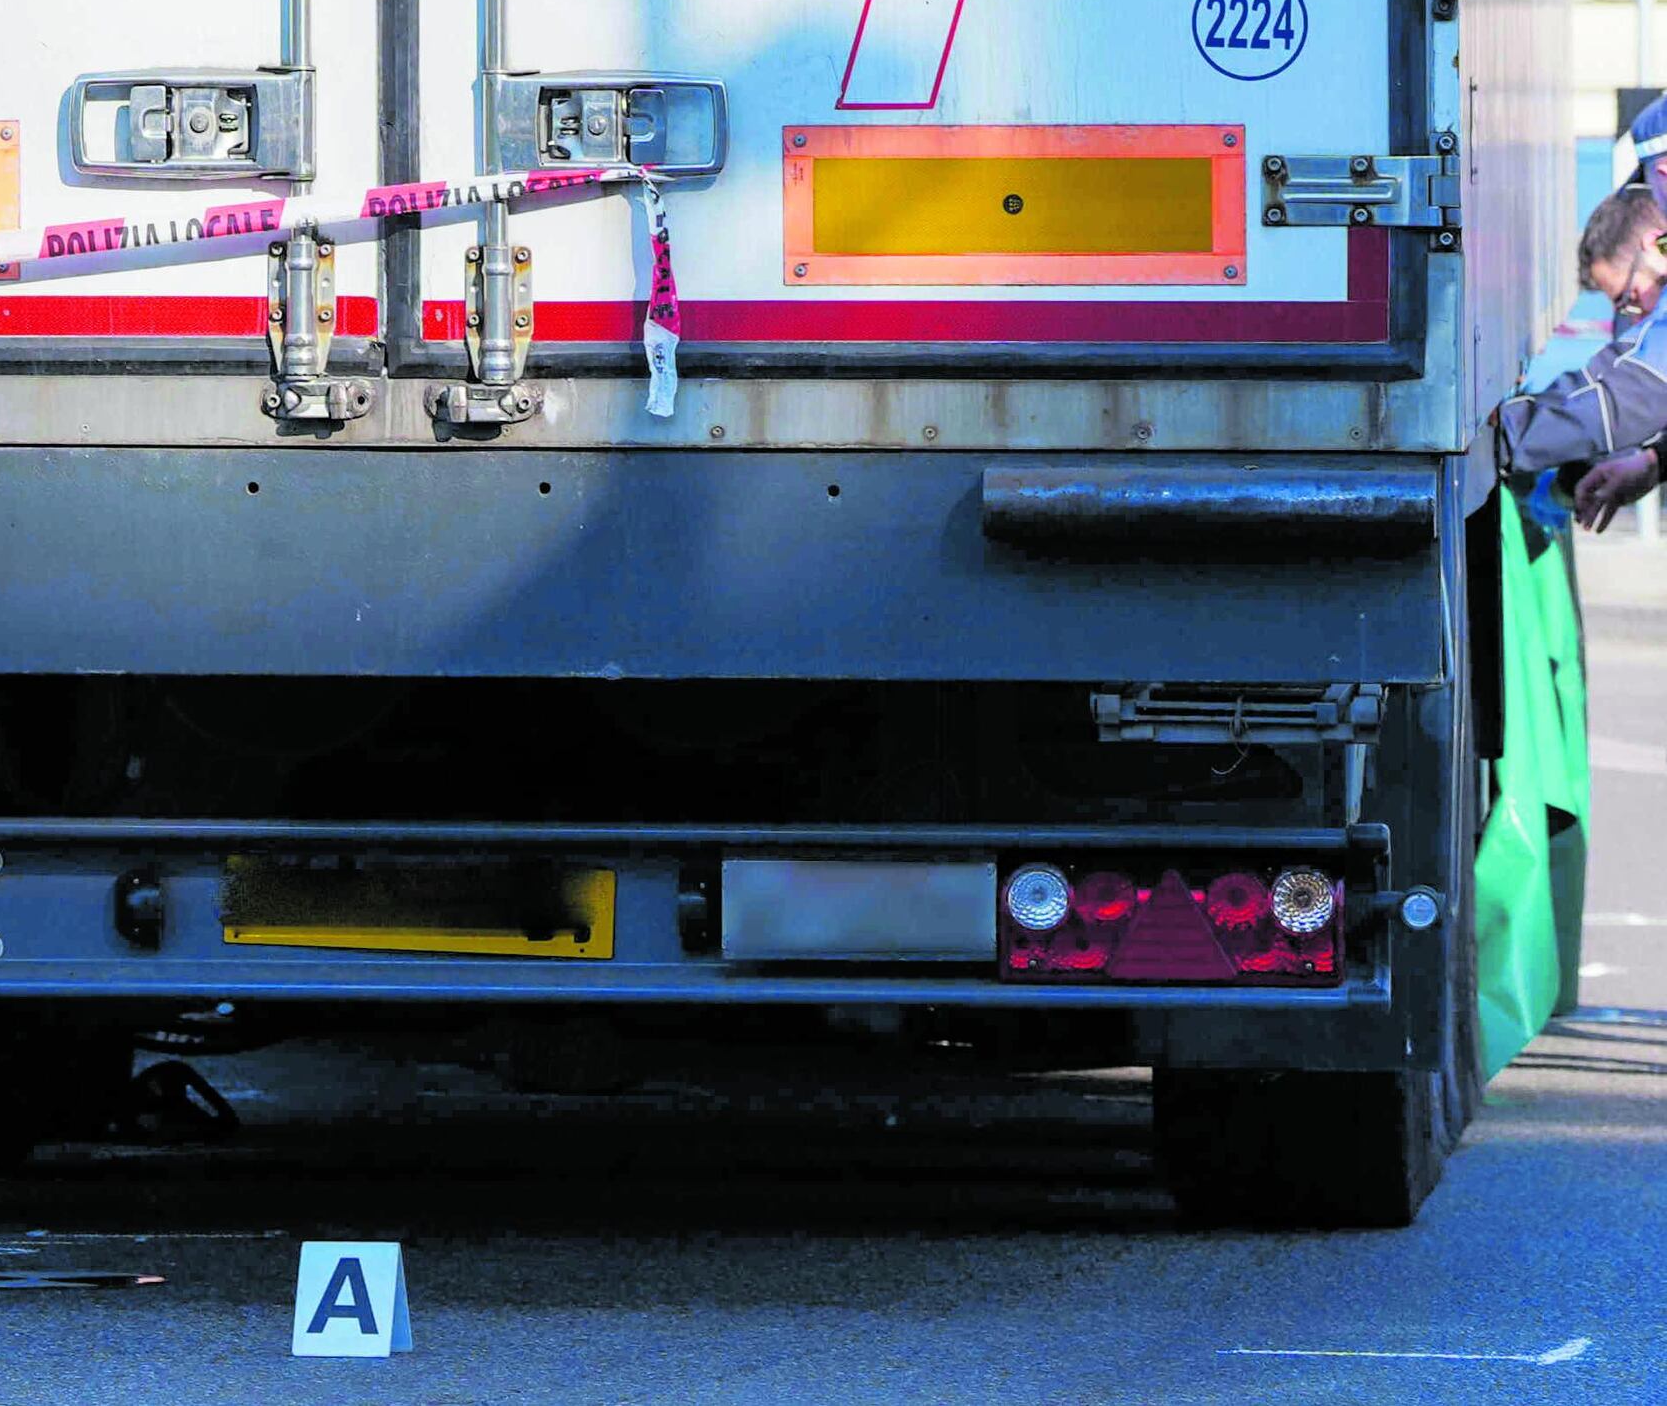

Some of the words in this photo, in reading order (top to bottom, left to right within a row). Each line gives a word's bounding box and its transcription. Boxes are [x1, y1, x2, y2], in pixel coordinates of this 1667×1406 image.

[47, 223, 160, 258] POLIZIA
[169, 209, 274, 243] LOCALE
[307, 1258, 379, 1335] A
